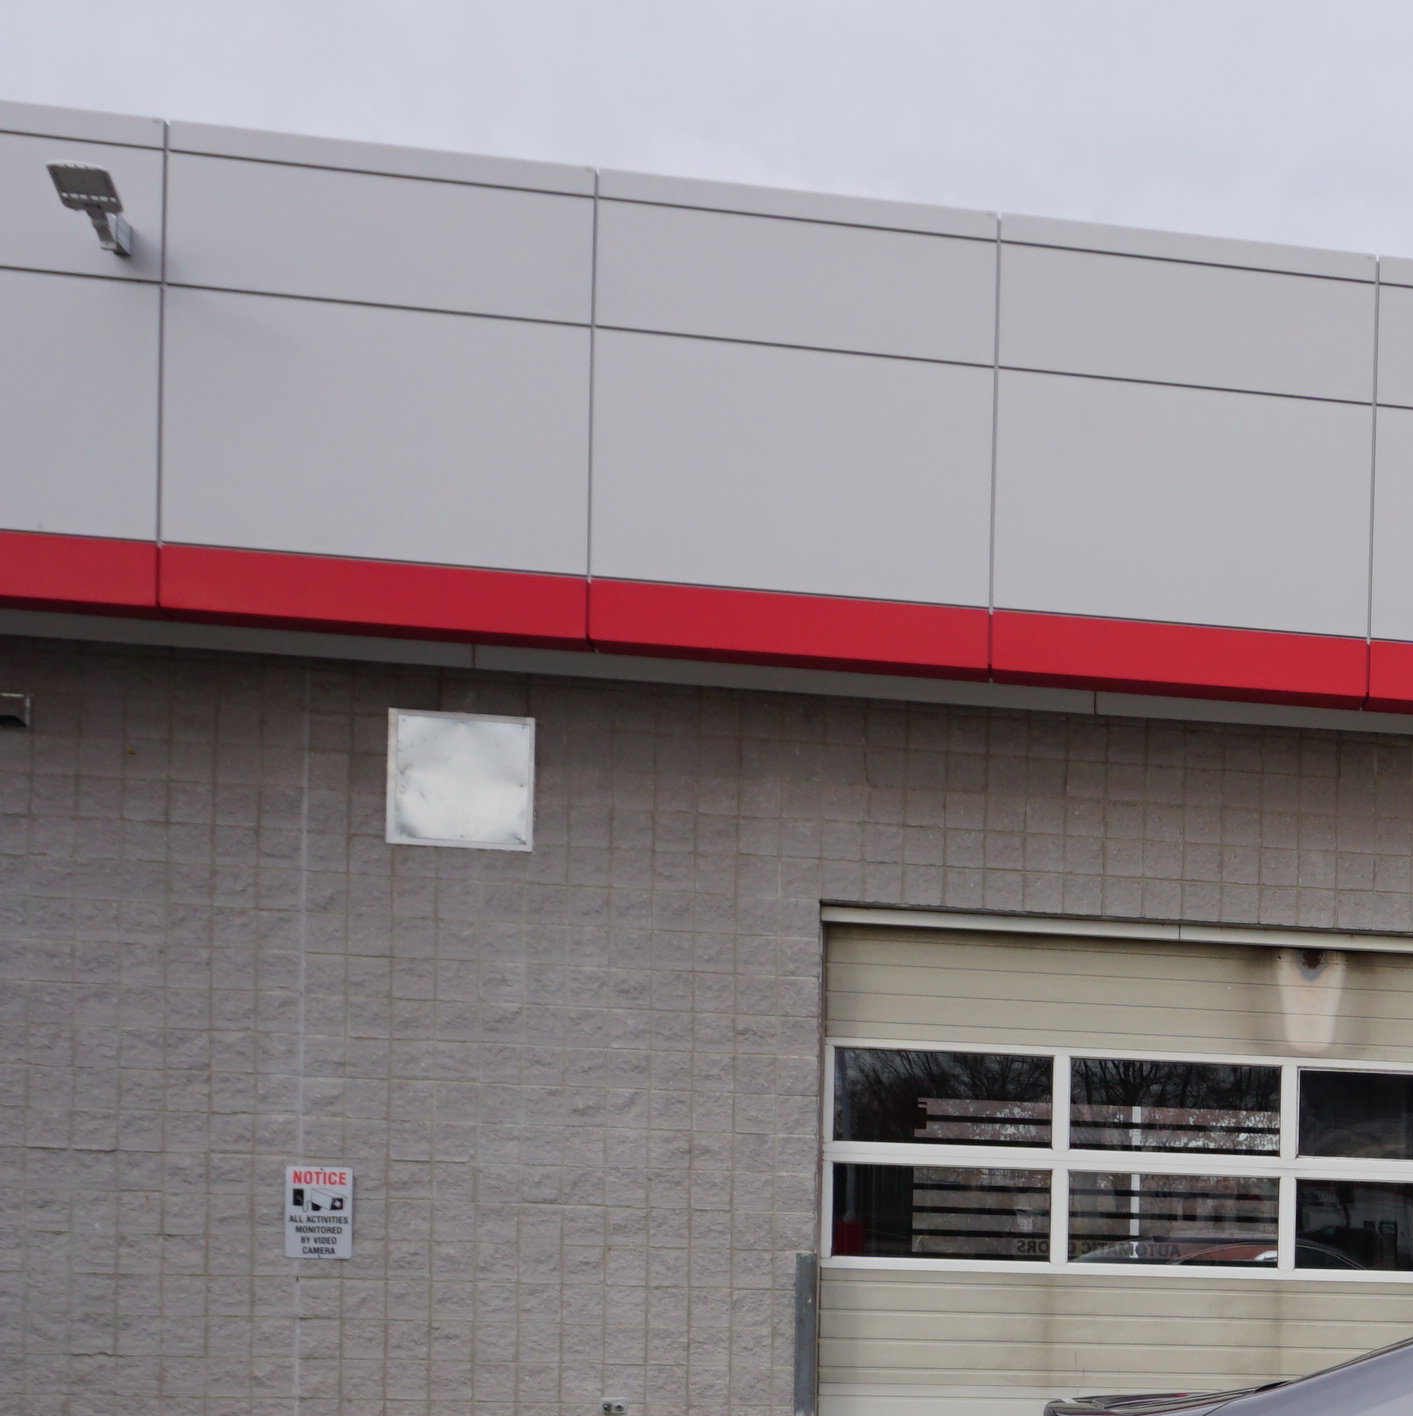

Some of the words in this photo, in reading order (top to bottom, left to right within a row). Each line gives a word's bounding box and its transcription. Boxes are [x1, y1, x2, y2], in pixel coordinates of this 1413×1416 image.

[293, 1170, 347, 1186] NOTICE
[289, 1215, 303, 1224] ALL
[306, 1215, 349, 1224] ACTIVITIES
[295, 1226, 342, 1235] MONITORED
[301, 1236, 311, 1244] BY
[313, 1236, 337, 1245] VIDEO
[302, 1246, 336, 1255] CAMERA
